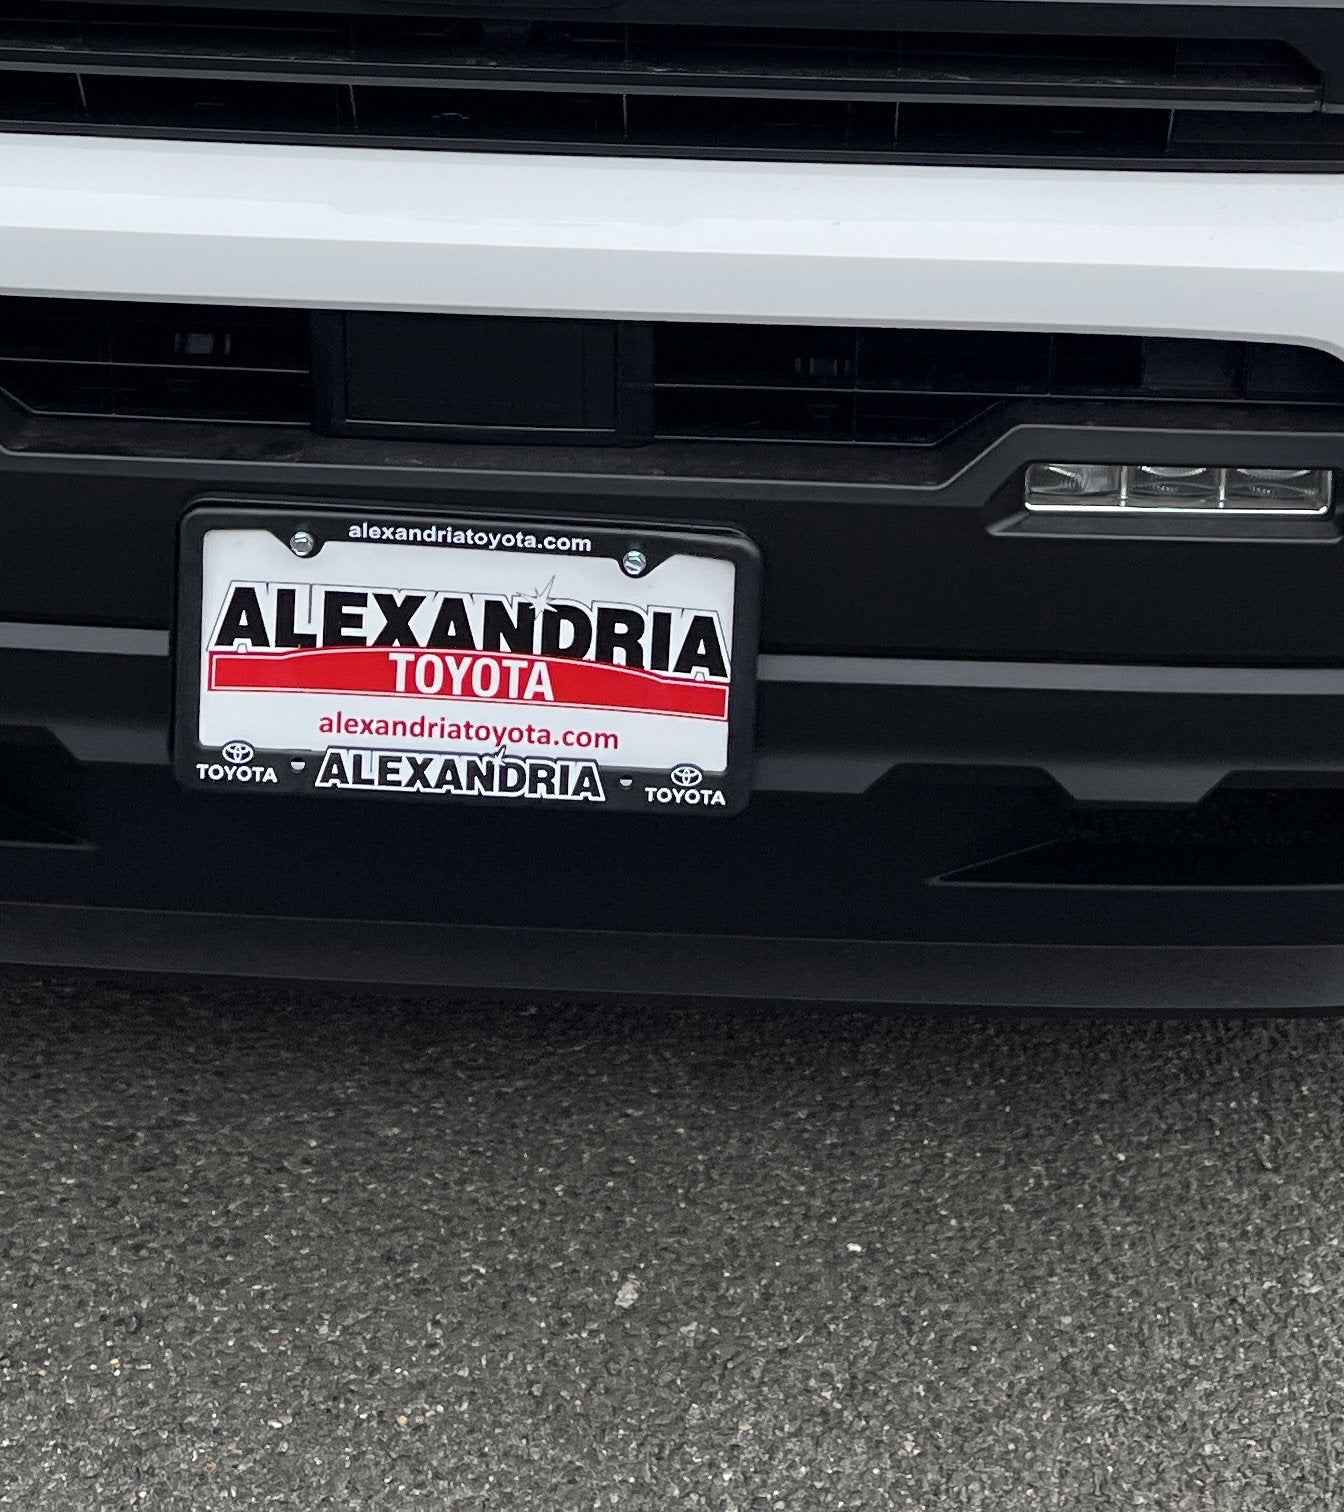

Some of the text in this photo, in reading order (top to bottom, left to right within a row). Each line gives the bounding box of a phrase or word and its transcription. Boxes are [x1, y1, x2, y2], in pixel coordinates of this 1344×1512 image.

[348, 521, 593, 552] alexandriatoyota.com
[212, 584, 730, 679] ALEXANDRIA
[388, 652, 556, 702] TOYOTA
[318, 710, 620, 751] alexandriatoyota.com
[195, 763, 279, 784] TOYOTA
[315, 748, 606, 802] ALEXANDRIA
[644, 787, 726, 806] TOYOTA
